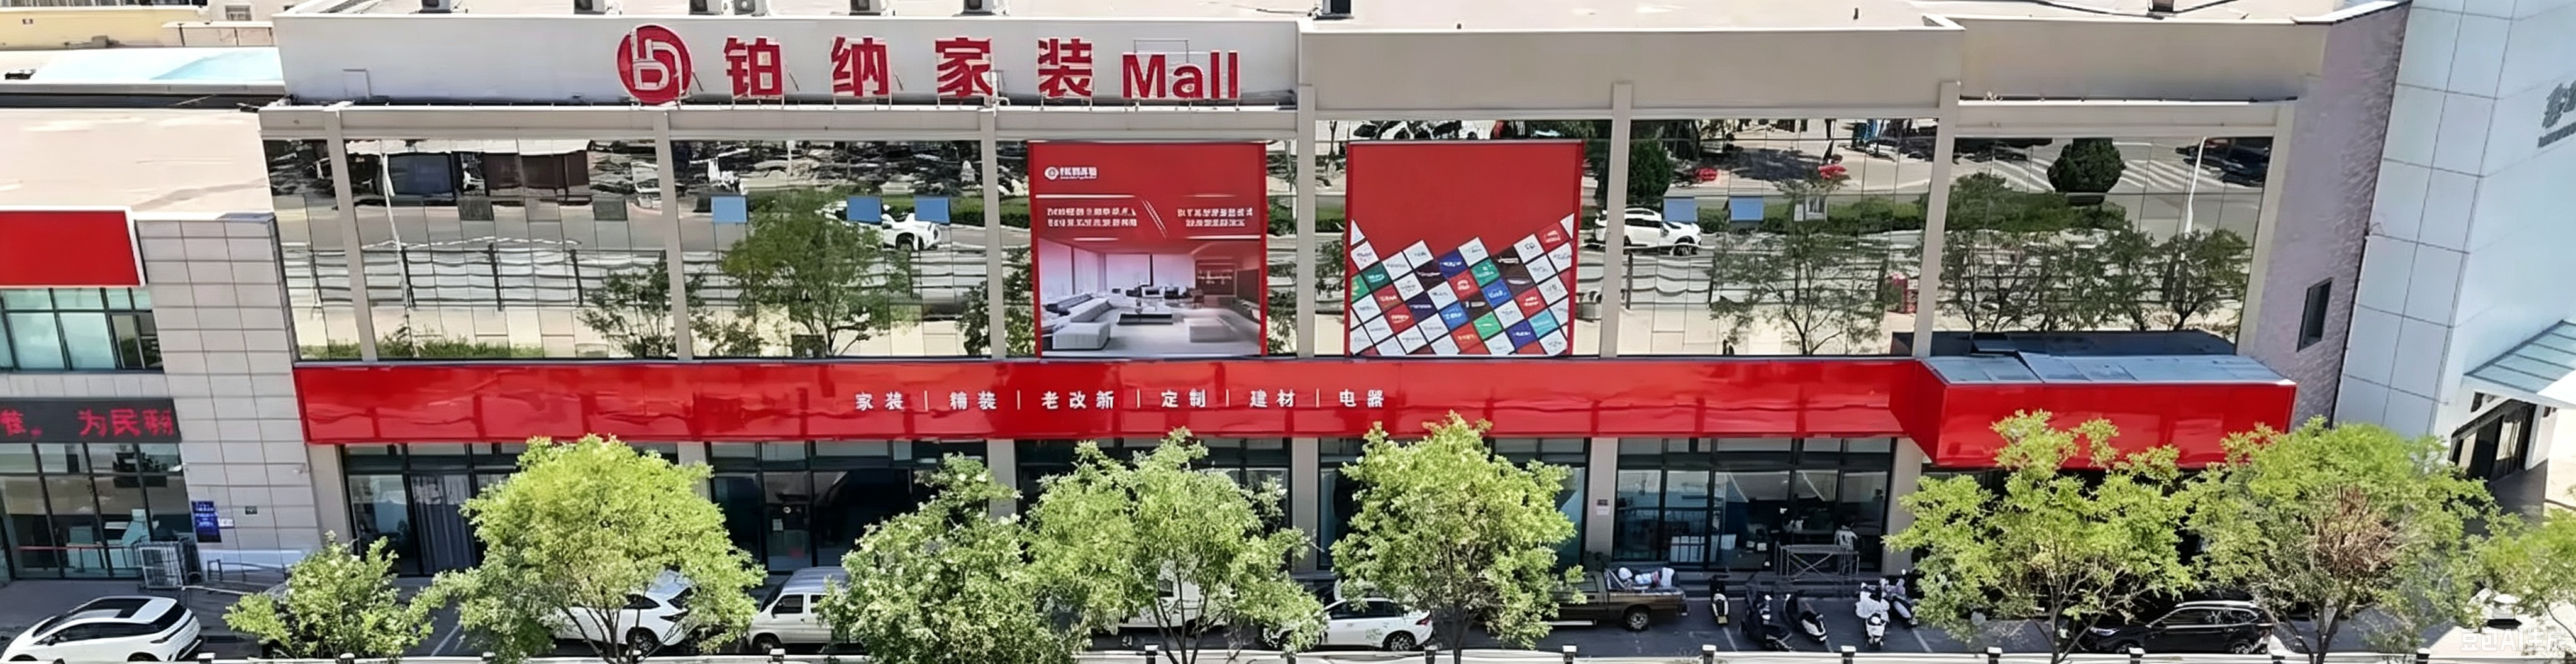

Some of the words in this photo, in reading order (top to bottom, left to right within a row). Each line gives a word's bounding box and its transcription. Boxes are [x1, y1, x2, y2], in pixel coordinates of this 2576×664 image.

[723, 36, 1093, 98] 铂纳家装
[1122, 50, 1241, 99] Mall
[855, 391, 904, 411] 家装
[1041, 390, 1114, 411] 老改新
[1161, 389, 1206, 408] 定制
[1250, 389, 1296, 408] 建材
[1339, 388, 1384, 409] 电器
